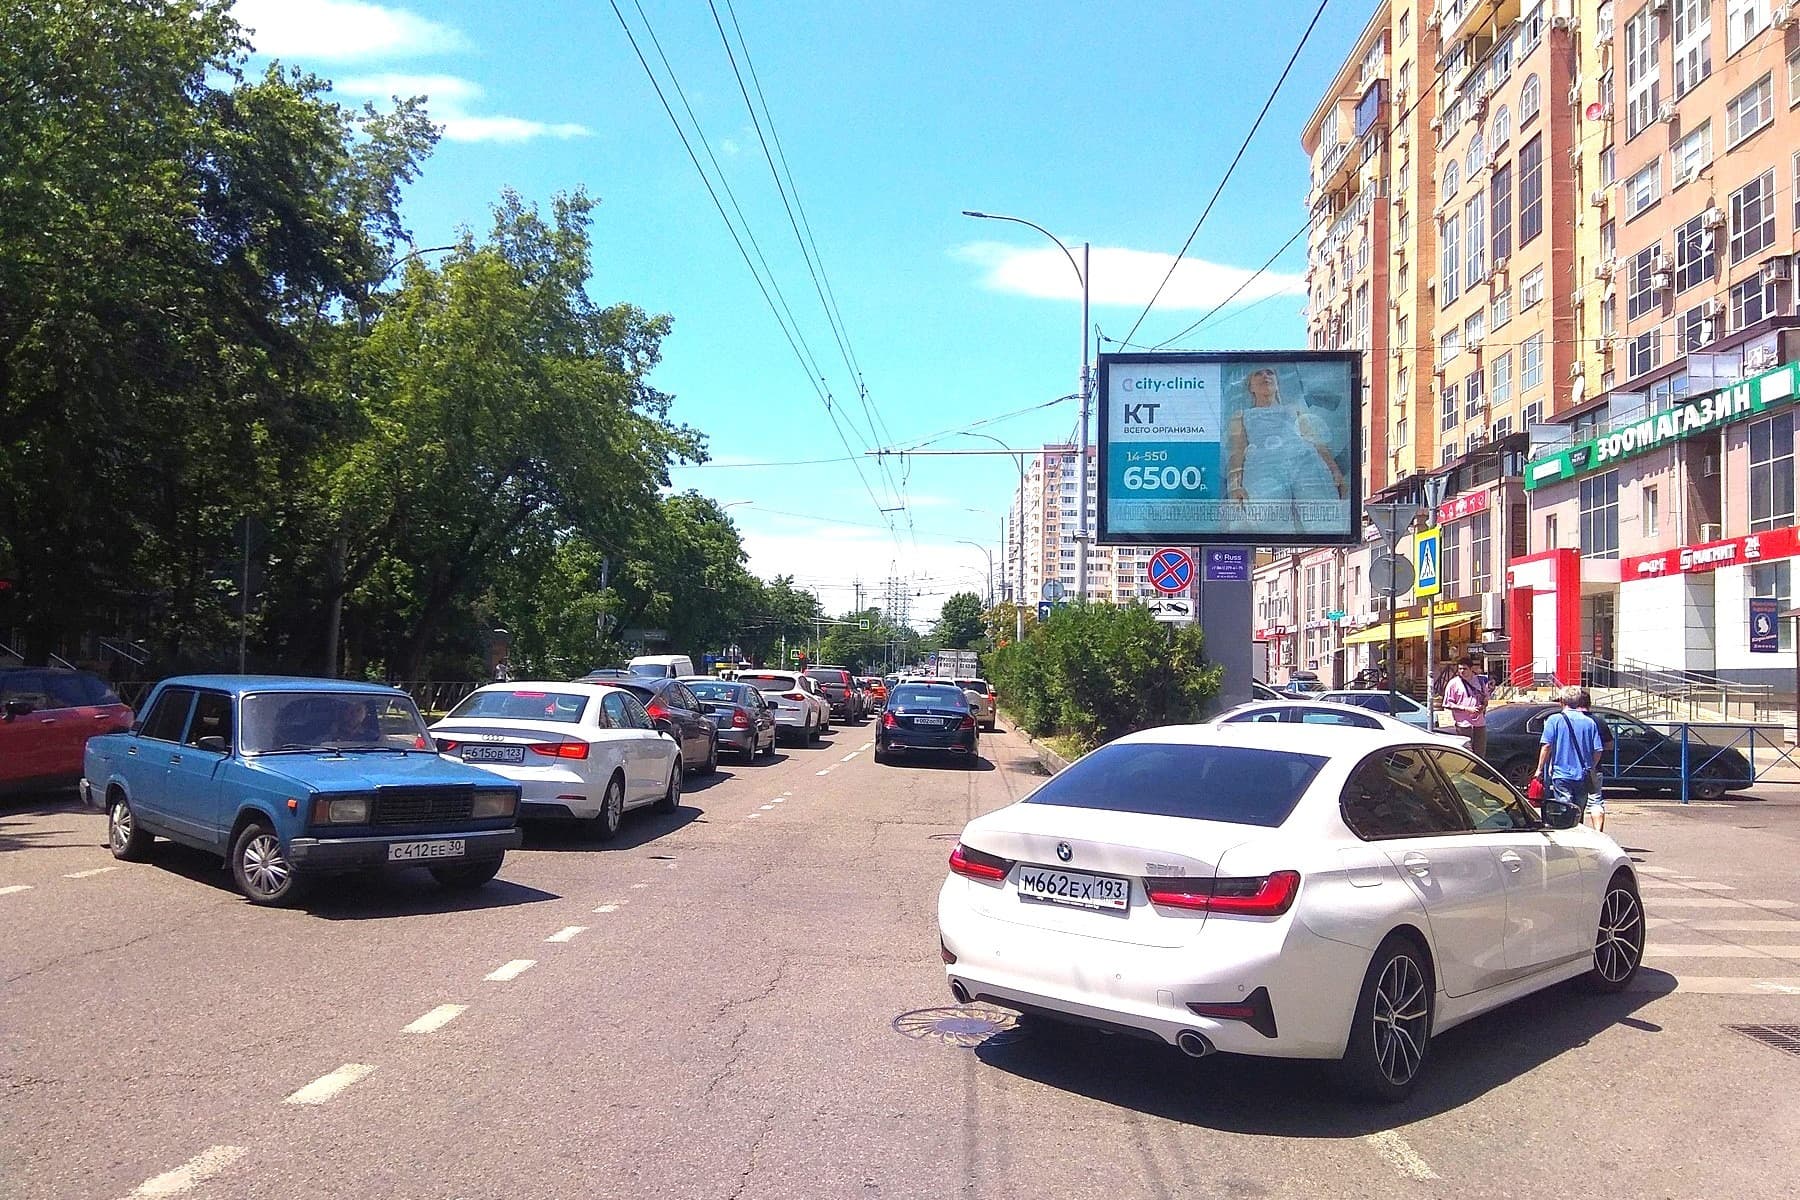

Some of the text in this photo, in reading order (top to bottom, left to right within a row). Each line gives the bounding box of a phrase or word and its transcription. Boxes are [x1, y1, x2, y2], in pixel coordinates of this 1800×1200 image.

[1124, 403, 1161, 424] КТ
[1597, 383, 1751, 462] ЗООМАГАЗИН
[1123, 426, 1206, 434] ВСЕГО ОРГАНИЗМА
[1224, 553, 1242, 561] Russ
[506, 748, 521, 757] 123
[394, 841, 461, 859] С412ЕЕ 30
[1023, 872, 1123, 900] М662ЕХ 193
